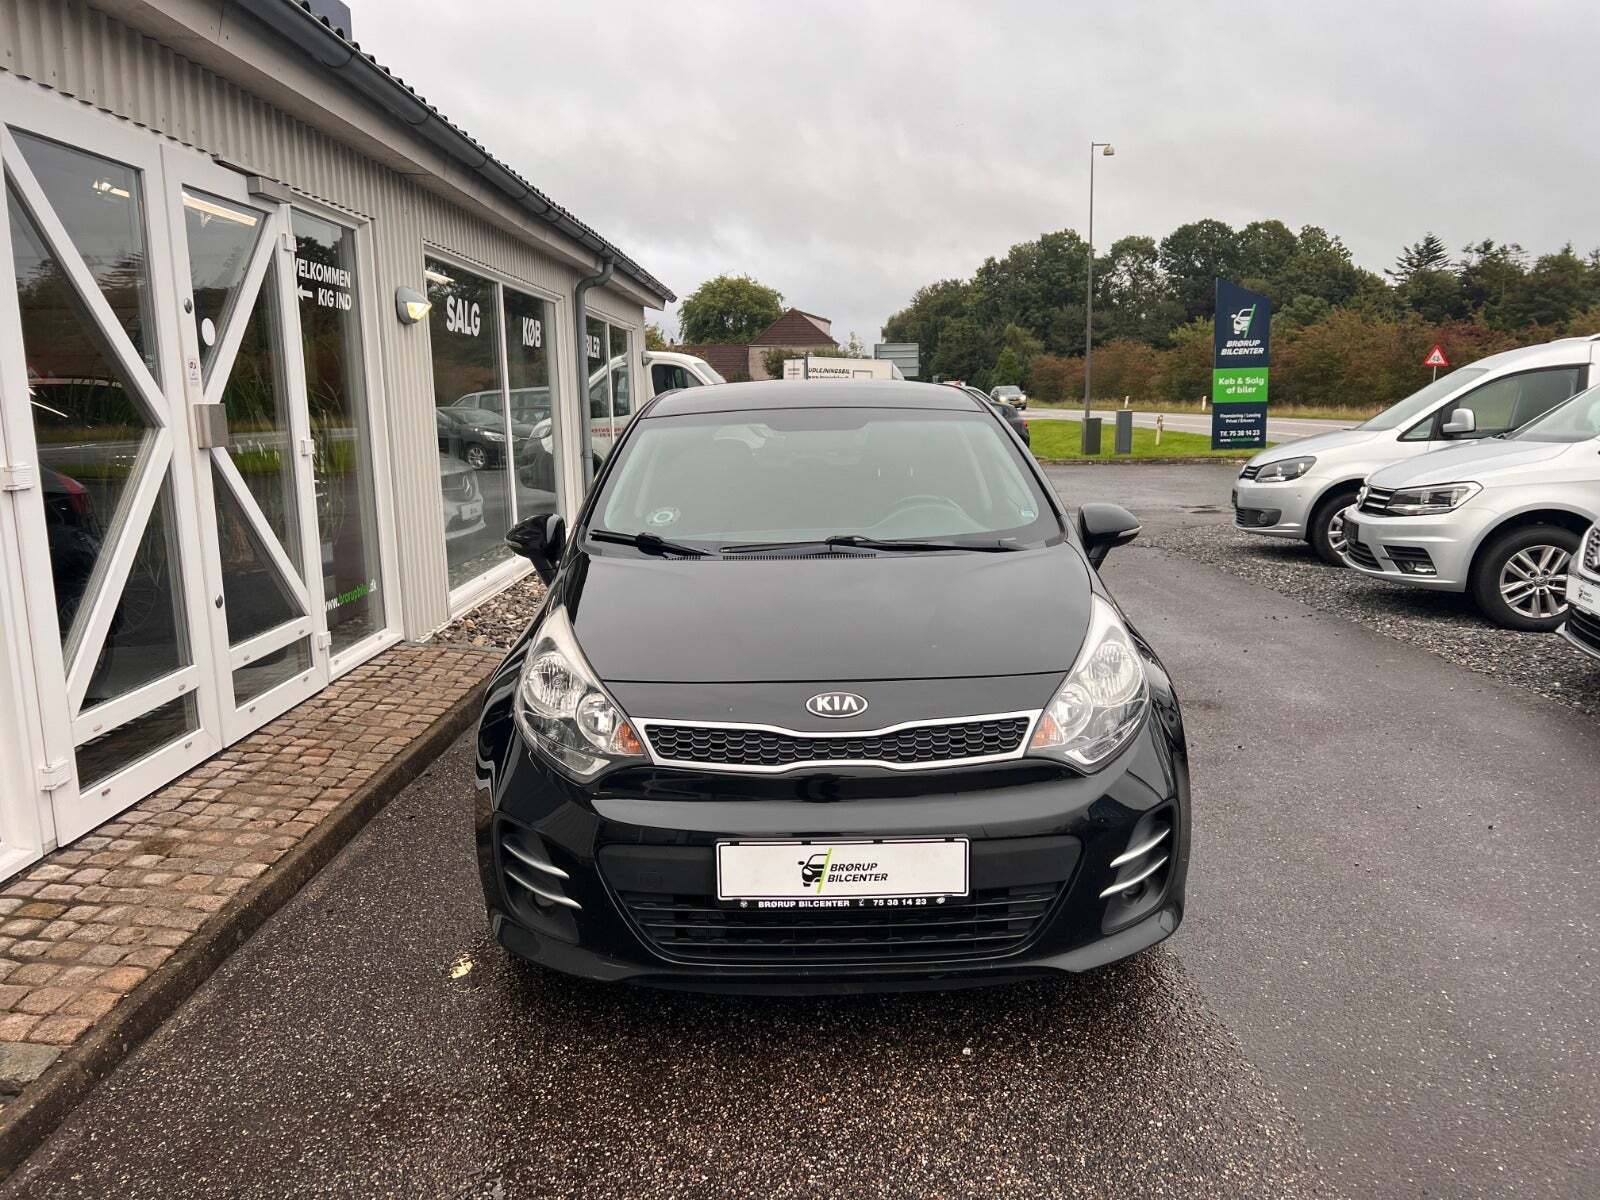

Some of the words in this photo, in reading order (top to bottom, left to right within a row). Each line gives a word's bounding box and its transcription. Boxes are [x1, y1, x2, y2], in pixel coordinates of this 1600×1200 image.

[295, 257, 351, 289] VELKOMMEN
[318, 287, 334, 308] KIG
[336, 291, 352, 311] IND
[446, 295, 481, 337] SALG
[522, 316, 541, 348] KØB
[1226, 339, 1261, 348] BRØRUP
[1220, 347, 1265, 356] BILCENTER
[1236, 377, 1244, 385] &
[1245, 376, 1265, 387] Salg
[1236, 385, 1257, 394] biler
[816, 695, 859, 712] KIA
[829, 862, 878, 873] BRØRUP
[827, 872, 889, 883] BILCENTER
[758, 899, 797, 909] BRØRUP
[798, 899, 850, 908] BILCENTER
[873, 898, 885, 907] 75
[887, 898, 899, 906] 38
[901, 898, 913, 906] 14
[915, 897, 927, 906] 23
